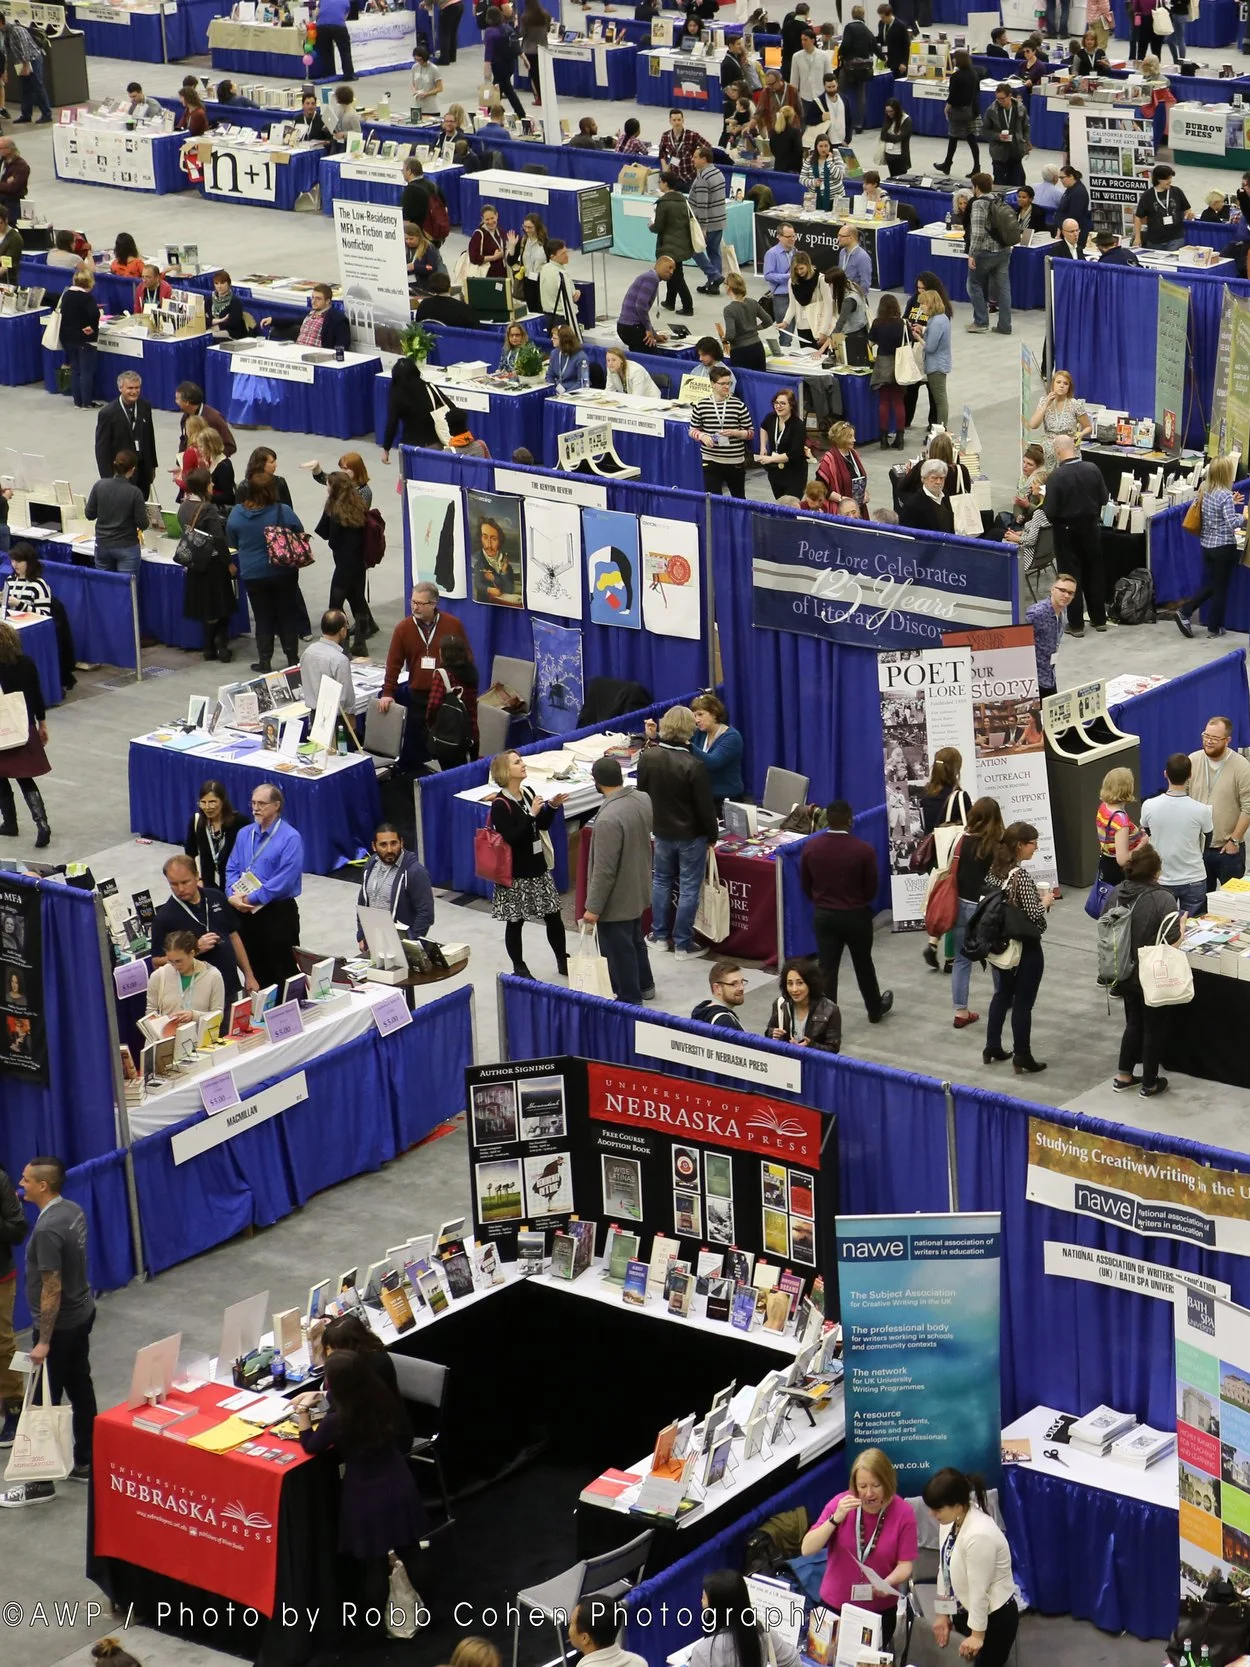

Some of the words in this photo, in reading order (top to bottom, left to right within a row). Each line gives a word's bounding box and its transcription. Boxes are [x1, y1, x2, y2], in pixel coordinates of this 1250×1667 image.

[1185, 122, 1223, 133] BURROW
[1185, 129, 1212, 139] PRESS
[210, 150, 273, 193] n+1
[1091, 178, 1107, 186] MFA
[1109, 180, 1147, 189] PROGRAM
[1092, 191, 1100, 199] IN
[1102, 192, 1136, 201] WRITING
[339, 207, 350, 219] The
[352, 209, 397, 227] Low-Residency
[340, 223, 354, 235] MFA
[356, 224, 361, 235] in
[362, 225, 383, 239] Fiction
[384, 229, 397, 241] and
[805, 232, 839, 250] spring
[342, 238, 374, 252] Nonfiction
[531, 481, 539, 490] THE
[539, 482, 556, 494] KENYON
[556, 485, 573, 495] REVIEW
[798, 541, 830, 563] Poet
[836, 548, 868, 570] Lore
[874, 554, 967, 587] Celebrates
[810, 567, 871, 624] 125
[866, 573, 959, 630] Years
[886, 661, 965, 688] POET
[929, 685, 966, 698] LORE
[971, 678, 1040, 699] story.
[984, 771, 1031, 784] OUTREACH
[1011, 792, 1047, 804] SUPPORT
[670, 1039, 705, 1056] UNIVERSITY
[706, 1048, 715, 1059] OF
[715, 1049, 747, 1067] NEBRASKA
[748, 1058, 768, 1073] PRESS
[480, 1066, 514, 1078] AUTHOR
[514, 1063, 555, 1074] SIGNINGS
[605, 1079, 712, 1108] UNIVERSITY
[721, 1103, 741, 1114] OF
[226, 1104, 258, 1127] MACMILLAN
[604, 1092, 741, 1139] NEBRASKA
[602, 1129, 618, 1138] FREE
[618, 1132, 645, 1144] COURSE
[747, 1131, 808, 1155] PRESS
[597, 1138, 632, 1151] ADOPTION
[632, 1145, 651, 1154] BOOK
[1036, 1132, 1088, 1163] Studying
[1197, 1175, 1207, 1193] in
[1211, 1181, 1235, 1198] the
[1078, 1188, 1131, 1220] nawe
[843, 1241, 904, 1258] nawe
[1062, 1248, 1094, 1263] NATIONAL
[1096, 1254, 1137, 1273] ASSOCIATION
[1138, 1264, 1145, 1274] OF
[1146, 1267, 1174, 1283] WRITERS
[851, 1292, 866, 1300] The
[869, 1290, 902, 1301] Subject
[905, 1289, 956, 1297] Association
[1188, 1295, 1208, 1313] BATH
[851, 1326, 868, 1335] The
[870, 1324, 925, 1335] professional
[927, 1323, 950, 1333] body
[1201, 1313, 1215, 1328] SPA
[852, 1368, 869, 1377] The
[871, 1367, 907, 1376] network
[853, 1411, 861, 1419] A
[862, 1411, 901, 1419] resource
[110, 1462, 195, 1497] UNIVERSITY
[201, 1494, 216, 1504] OF
[109, 1473, 217, 1526] NEBRASKA
[221, 1520, 273, 1544] PRESS
